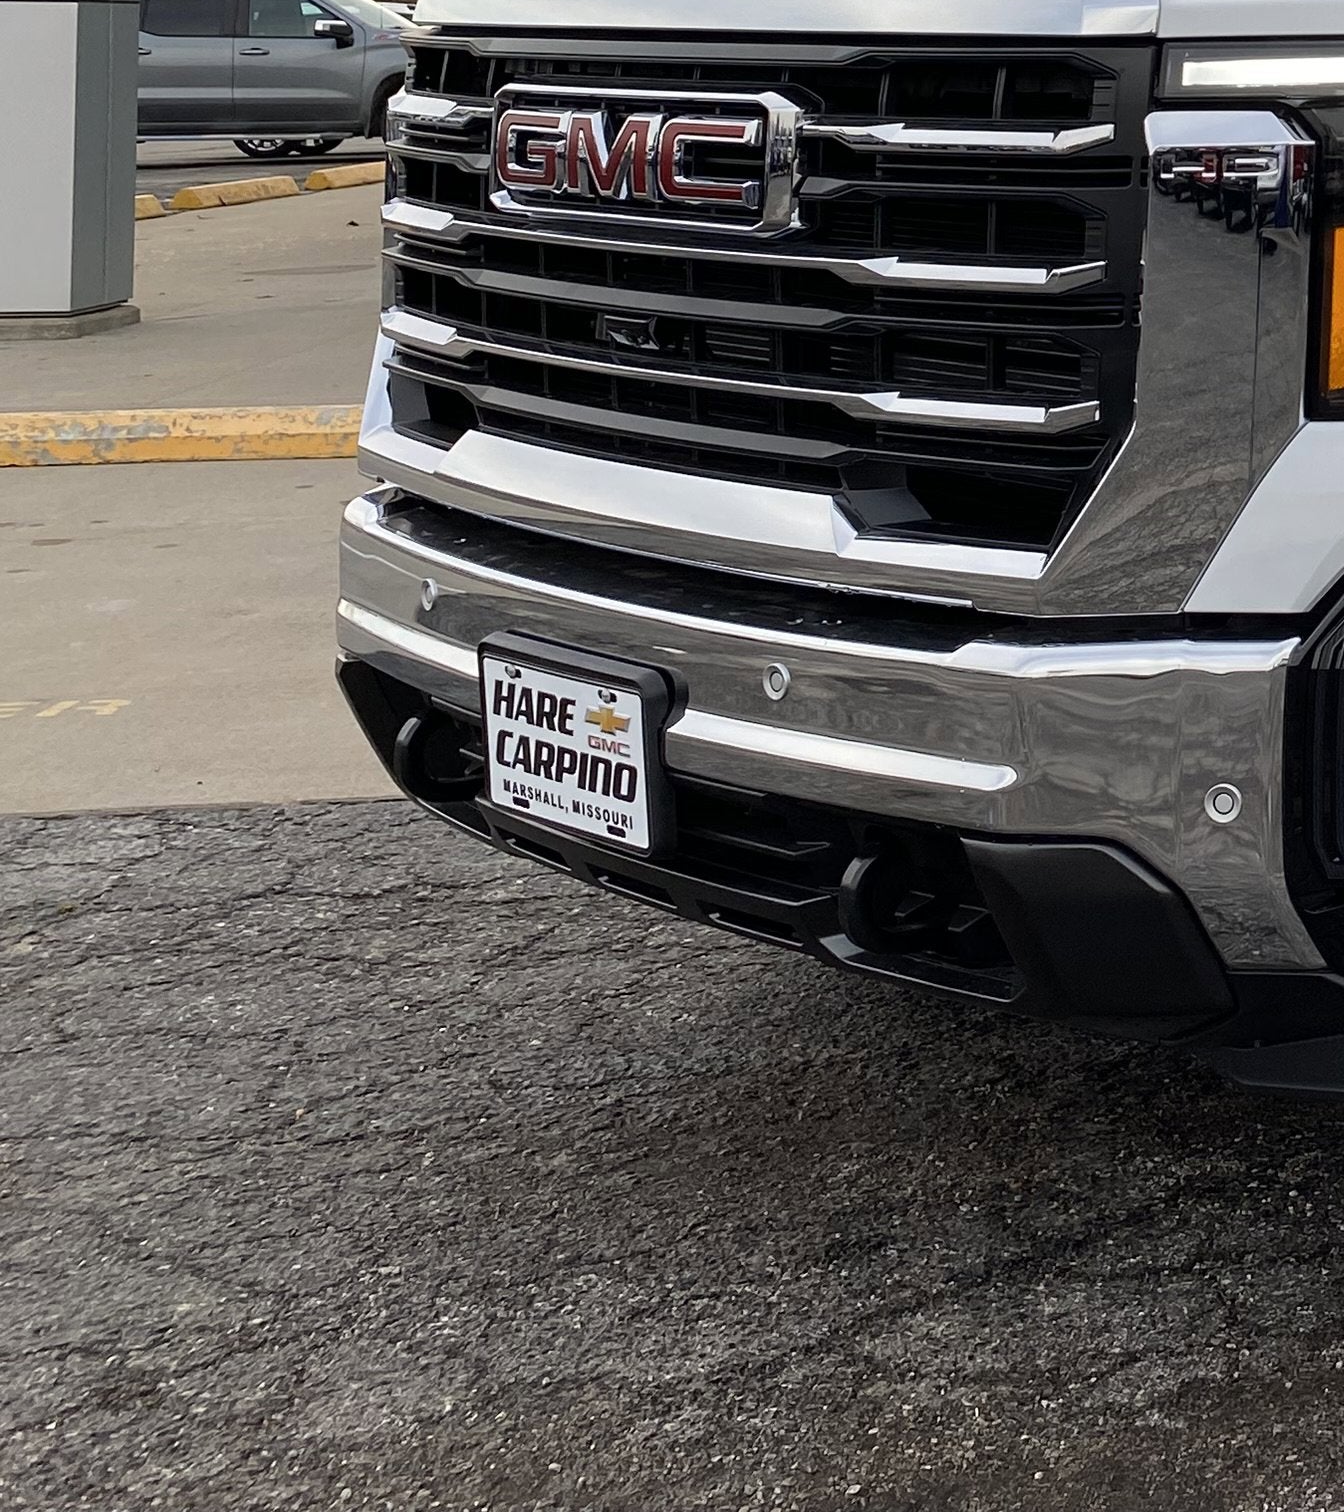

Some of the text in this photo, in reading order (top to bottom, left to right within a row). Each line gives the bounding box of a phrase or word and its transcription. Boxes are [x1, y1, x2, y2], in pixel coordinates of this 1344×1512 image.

[497, 108, 762, 209] GMC
[492, 679, 577, 736] HARE
[496, 729, 638, 803] CARPINO
[588, 734, 631, 758] GMC
[503, 778, 633, 829] MARSHALL, MISSOURI
